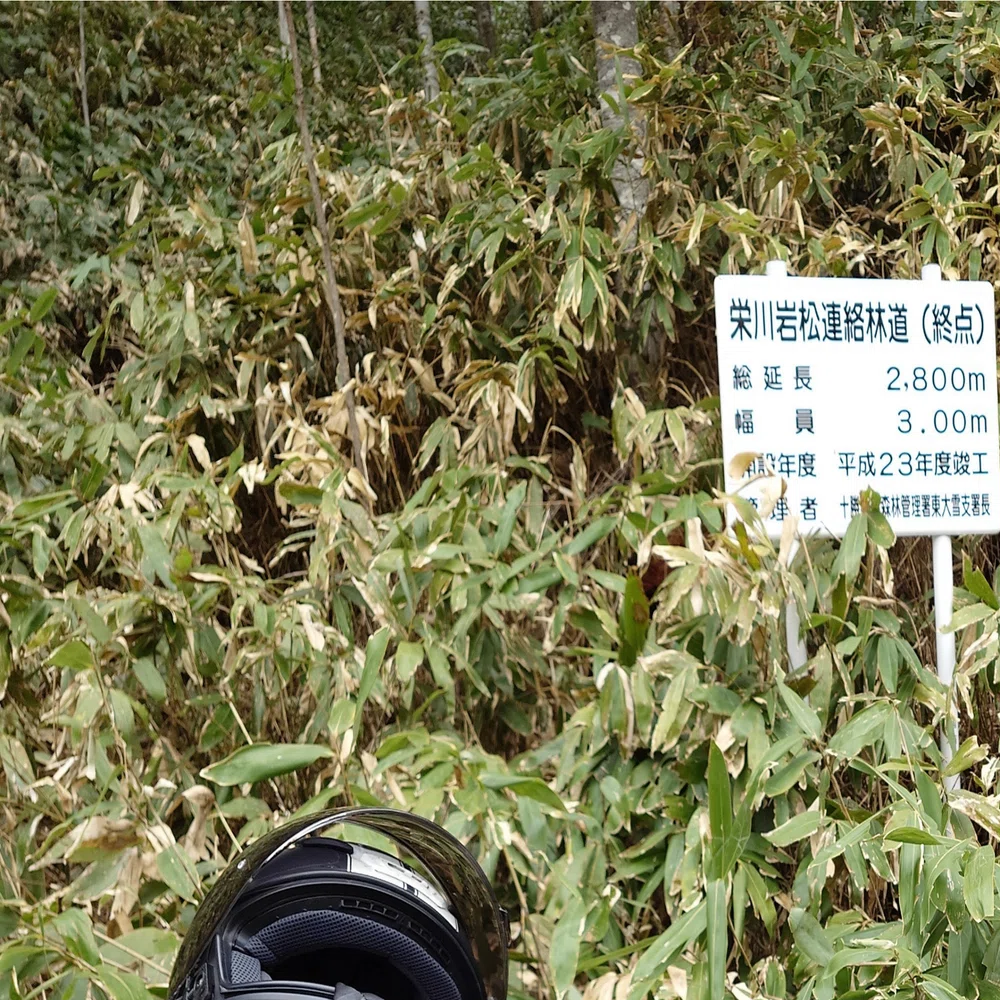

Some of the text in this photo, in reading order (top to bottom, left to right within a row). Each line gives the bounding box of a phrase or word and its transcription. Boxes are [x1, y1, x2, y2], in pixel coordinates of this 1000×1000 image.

[886, 366, 986, 392] 2,800m
[897, 409, 988, 434] 3.00m
[840, 492, 991, 518] 十勝森林管理署東大雪支署長
